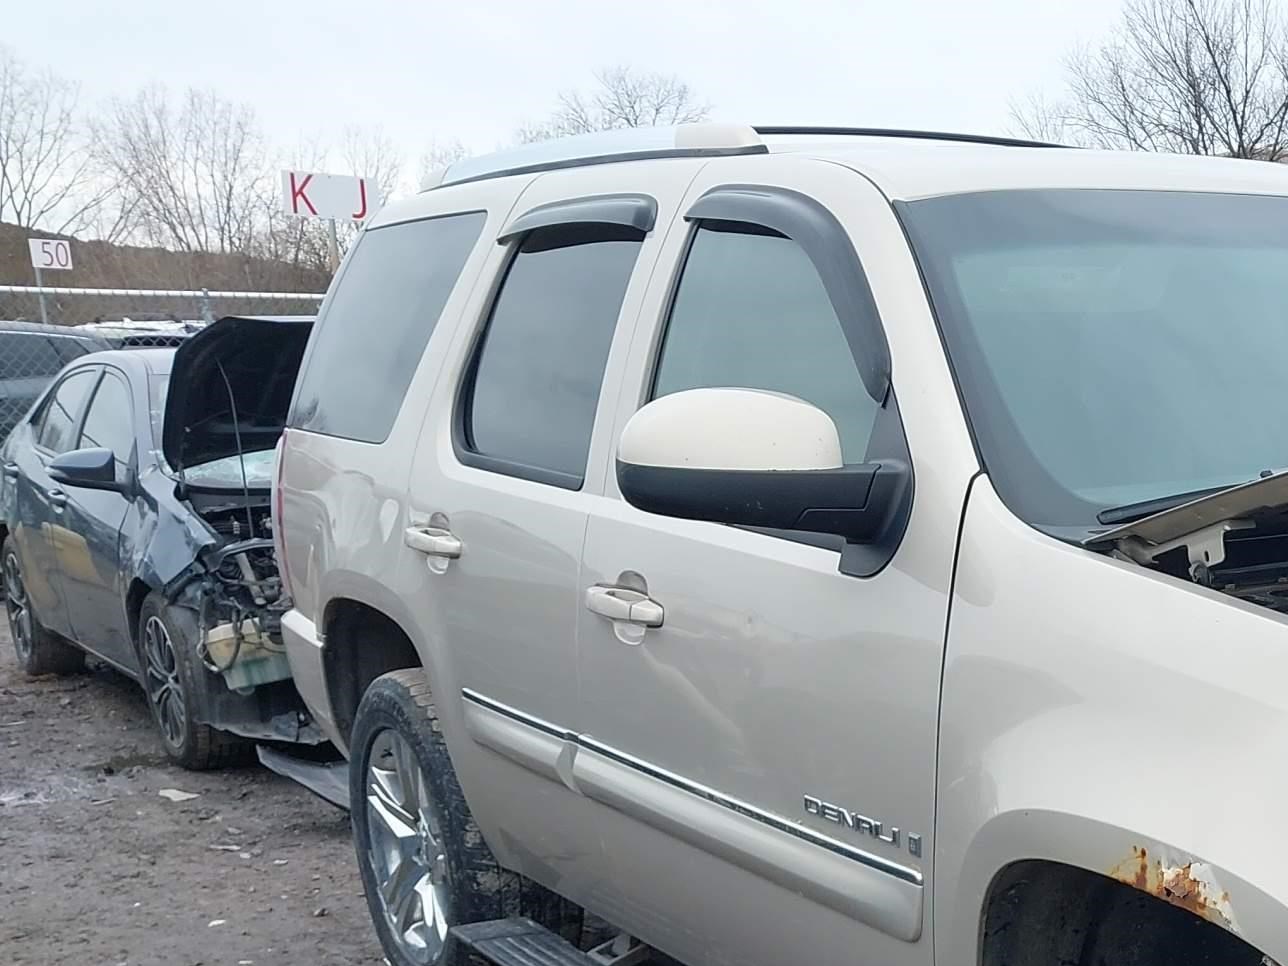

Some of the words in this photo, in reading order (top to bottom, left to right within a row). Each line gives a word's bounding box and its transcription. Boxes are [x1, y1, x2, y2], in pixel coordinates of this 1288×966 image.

[289, 172, 318, 216] K
[351, 178, 367, 219] J
[41, 241, 69, 268] 50
[803, 793, 901, 849] DENALI
